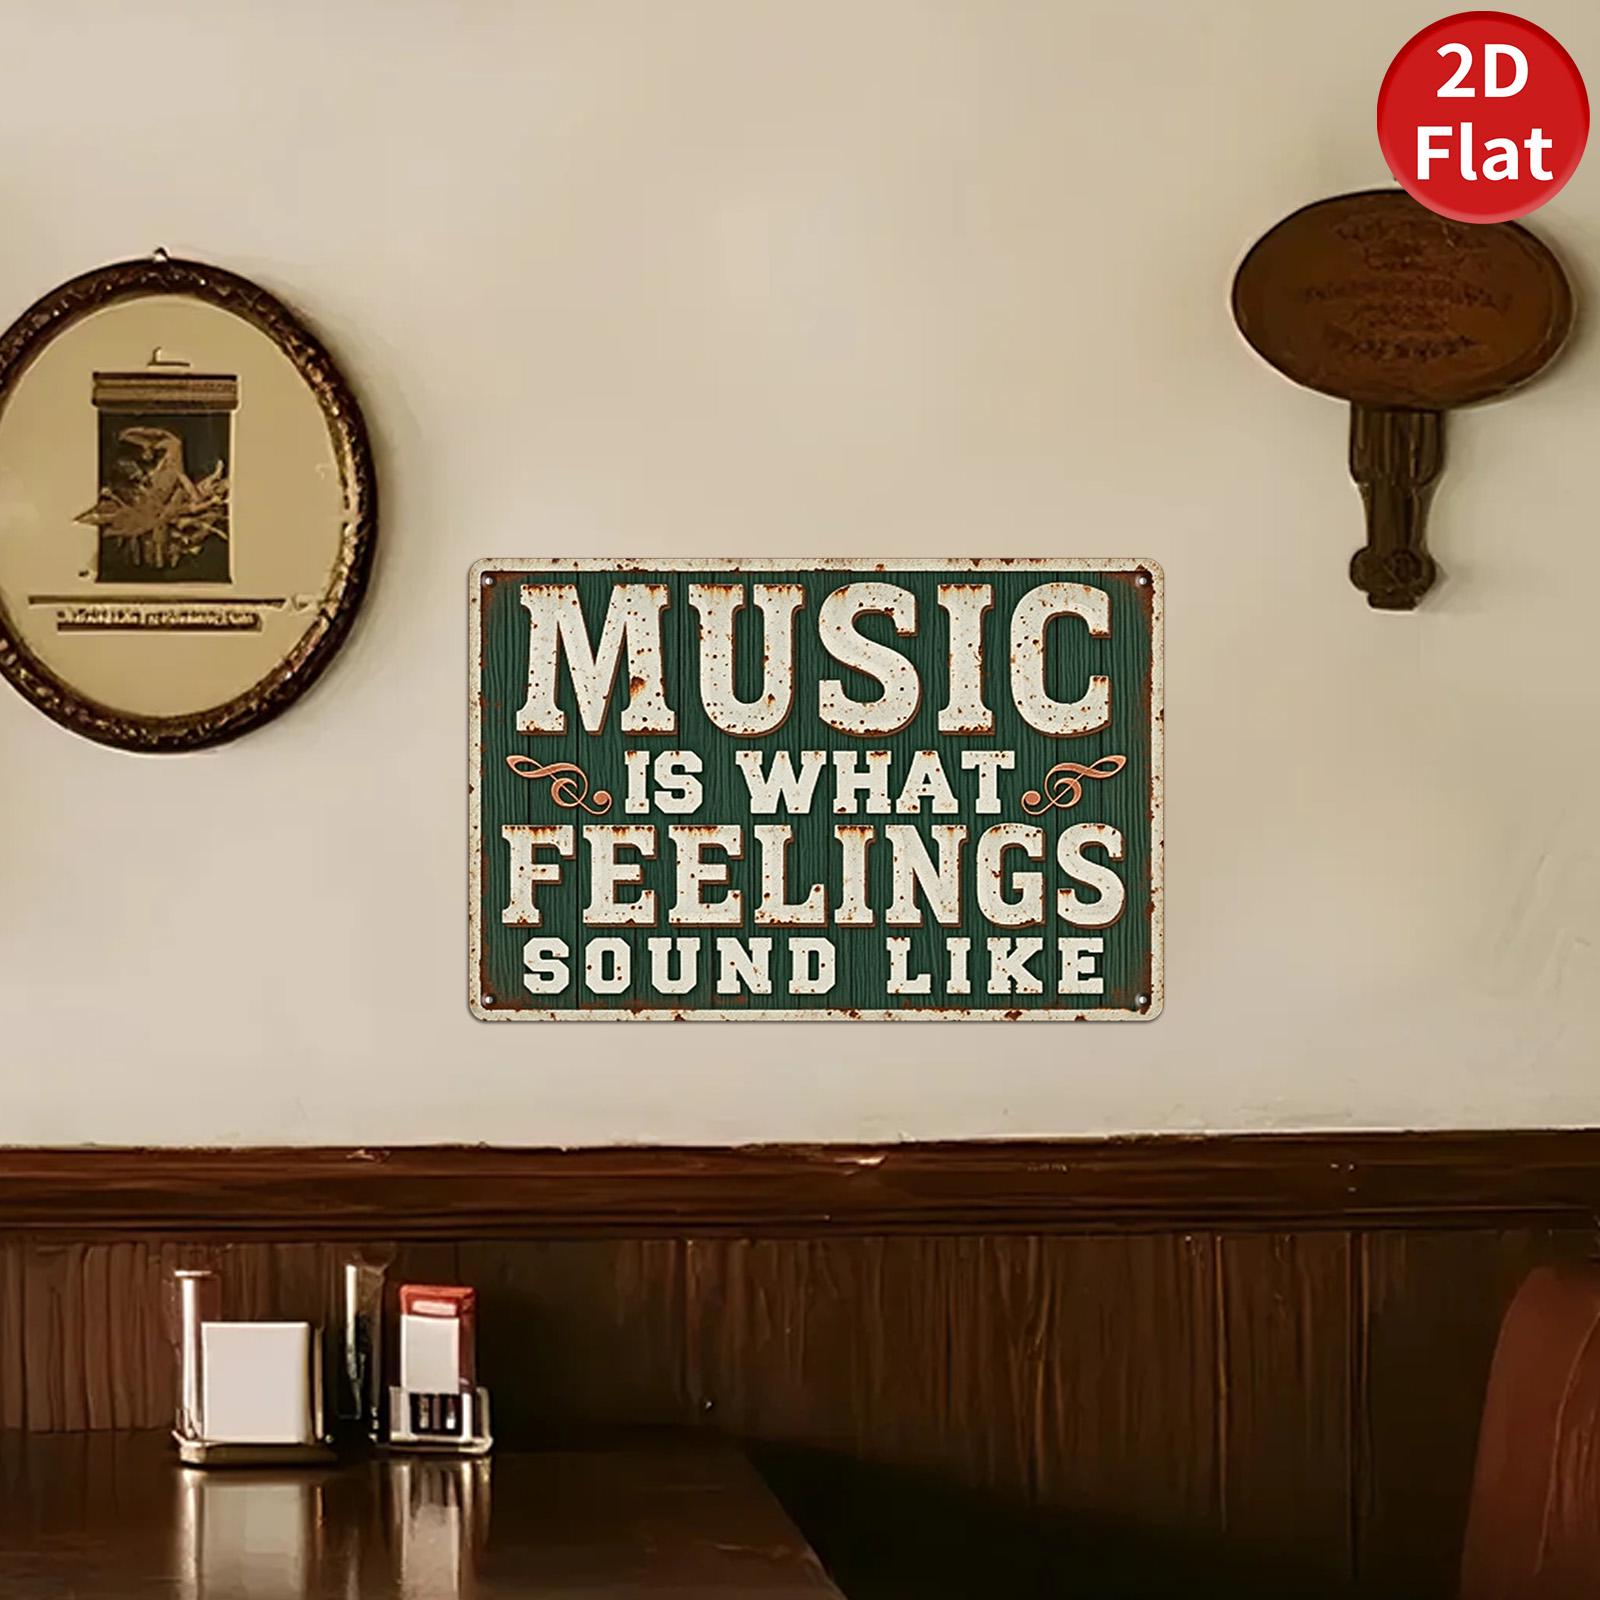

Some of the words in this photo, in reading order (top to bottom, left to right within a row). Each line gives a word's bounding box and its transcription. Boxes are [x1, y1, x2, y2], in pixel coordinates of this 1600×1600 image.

[515, 582, 1112, 736] MUSIC
[624, 750, 704, 814] IS
[735, 750, 1015, 814] WHAT
[501, 823, 1127, 927] FEELINGS
[523, 937, 836, 995] SOUND
[886, 937, 1105, 995] LIKE
